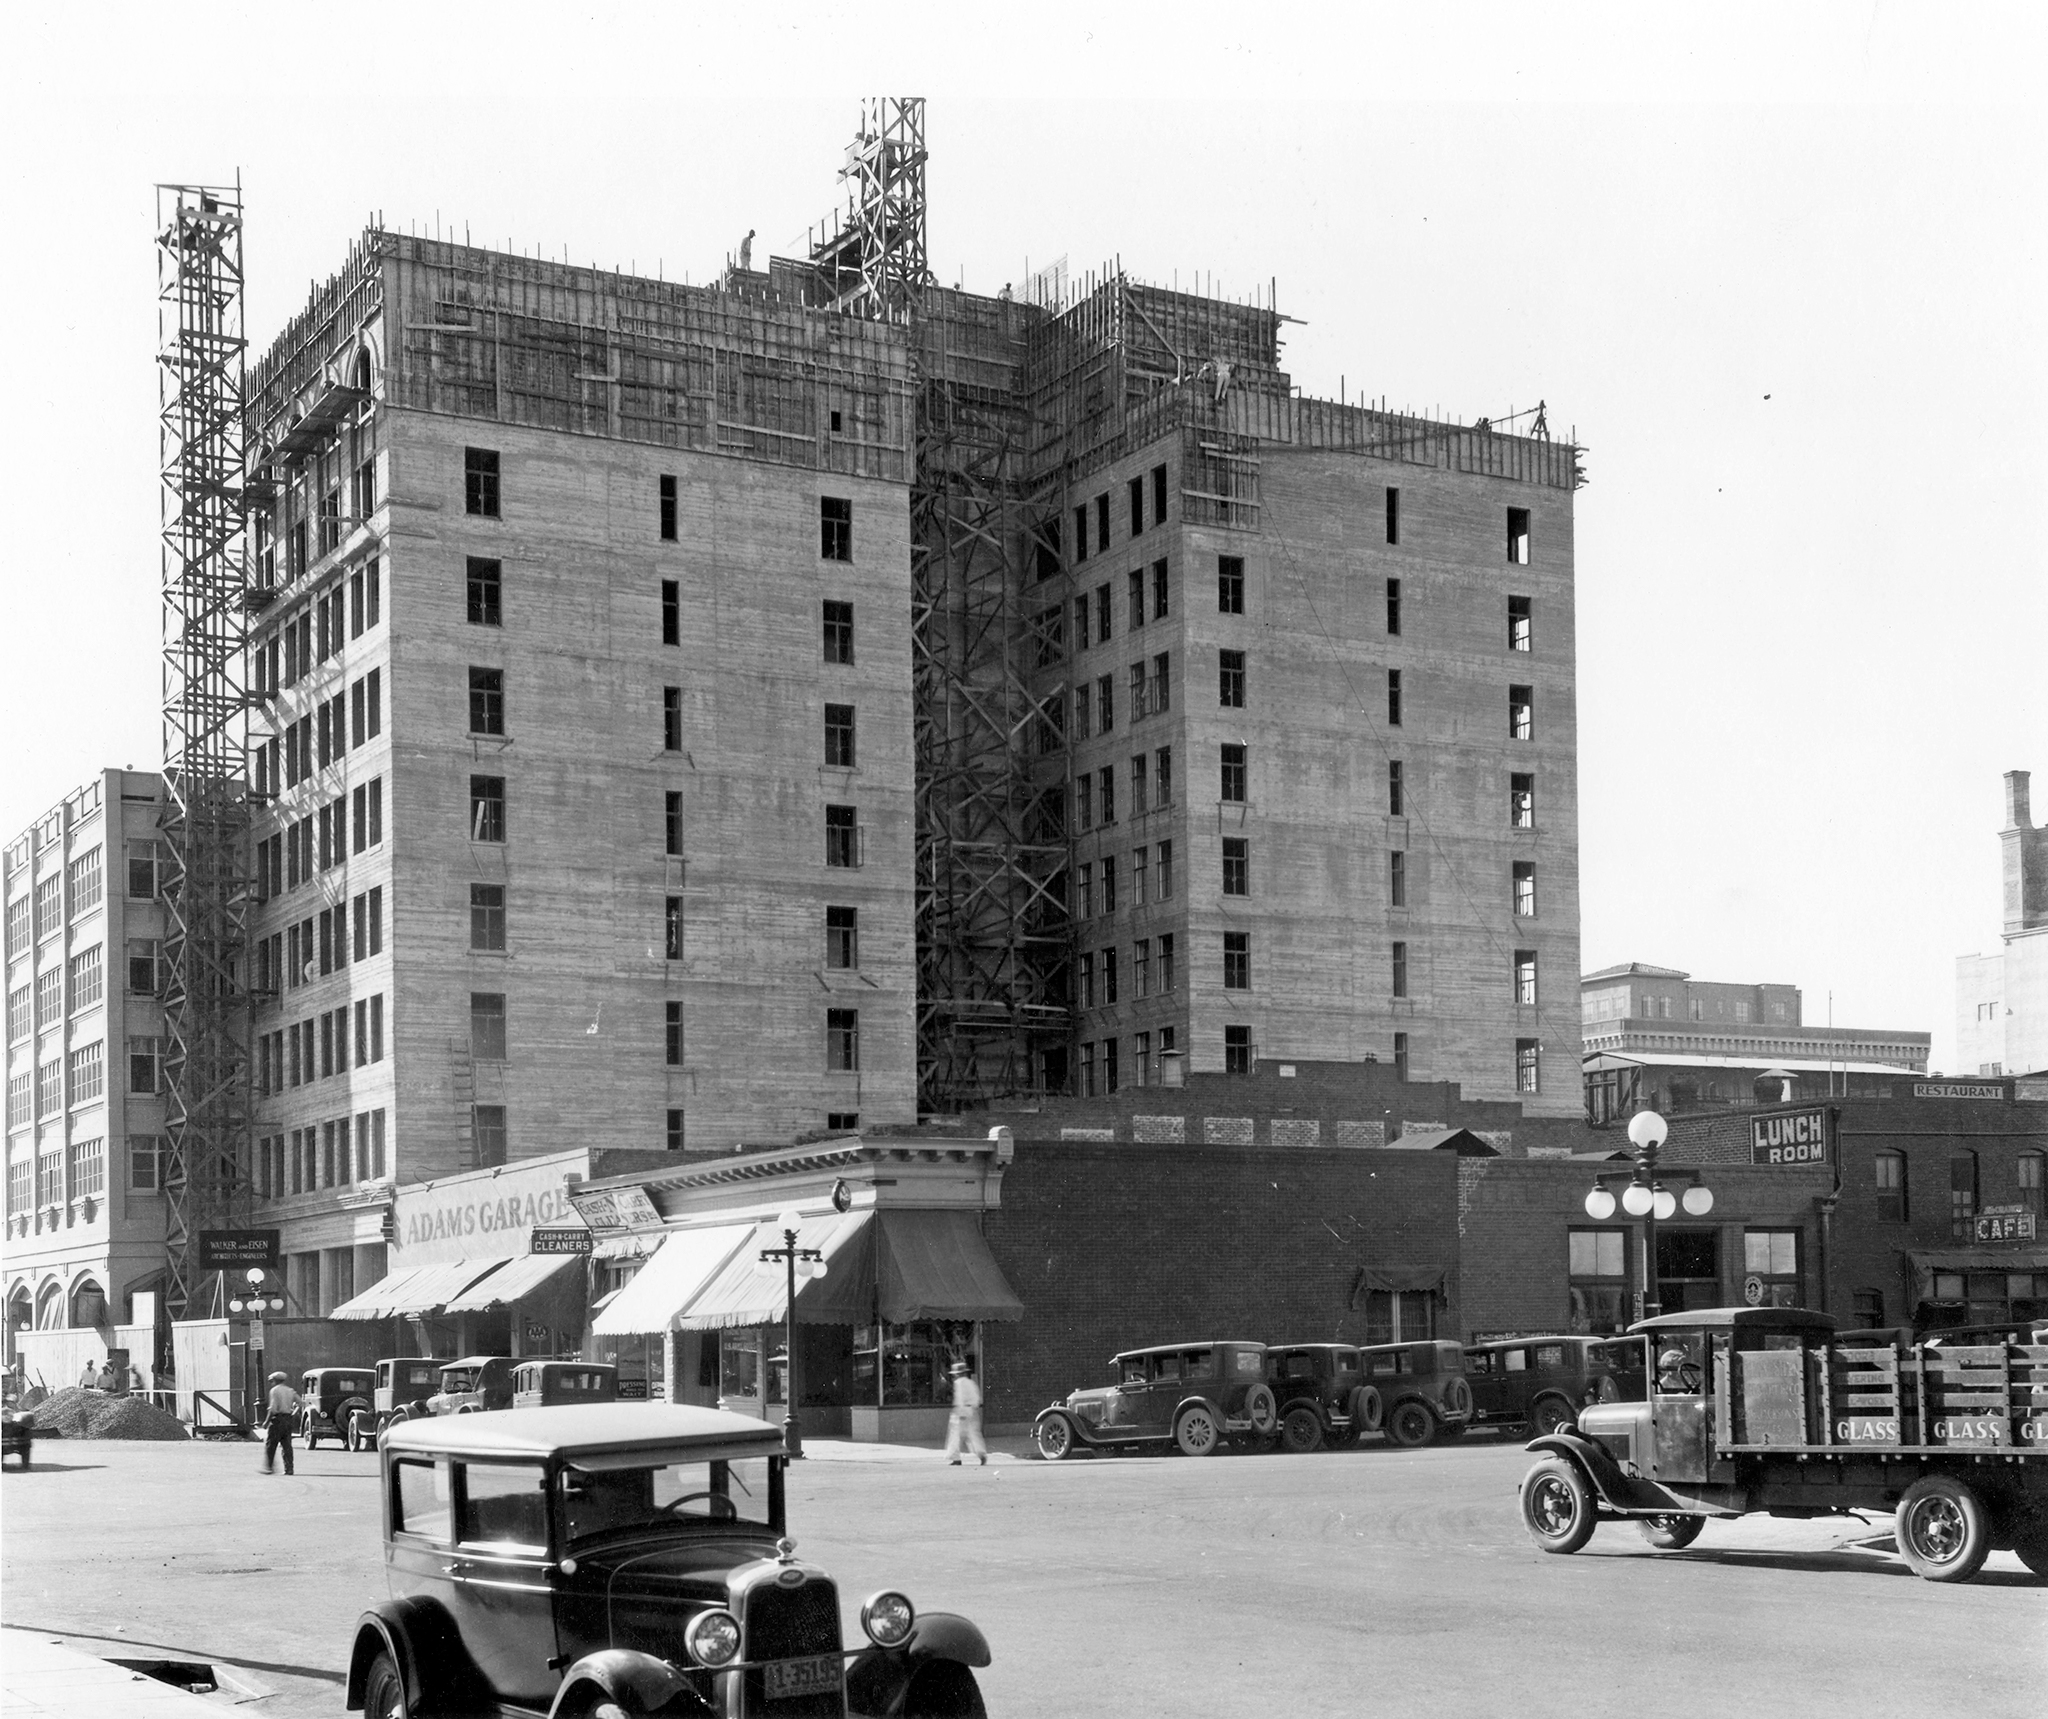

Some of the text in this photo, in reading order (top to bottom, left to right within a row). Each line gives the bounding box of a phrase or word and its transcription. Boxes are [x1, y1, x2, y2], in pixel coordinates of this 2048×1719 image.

[1917, 1085, 1999, 1099] RESTAURANT
[1755, 1115, 1822, 1147] LUNCH
[1769, 1143, 1822, 1163] ROOM
[407, 1188, 569, 1244] ADAMS GARAGE
[1977, 1218, 2031, 1239] CAFE
[210, 1241, 237, 1250] WALKER
[248, 1240, 268, 1250] EISEN
[534, 1240, 590, 1252] CLEANERS
[1837, 1421, 1896, 1440] GLASS
[1934, 1421, 2000, 1439] GLASS
